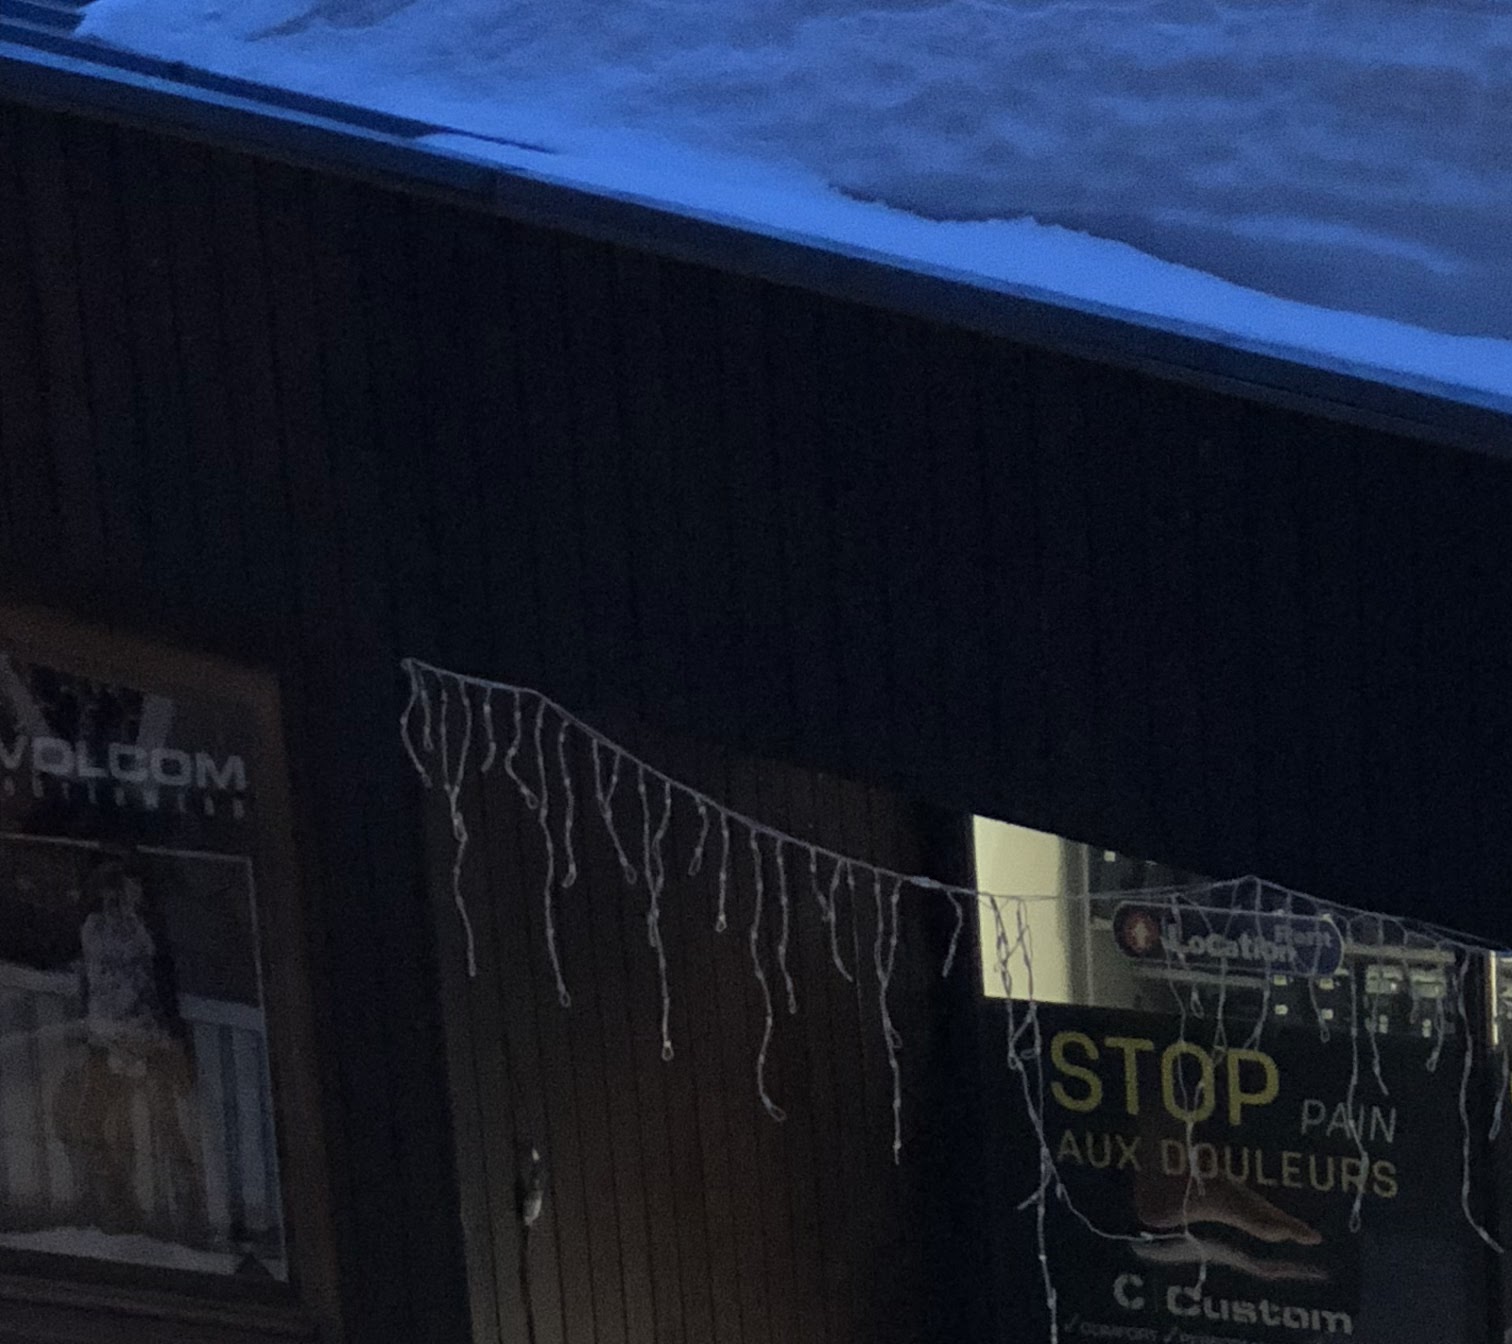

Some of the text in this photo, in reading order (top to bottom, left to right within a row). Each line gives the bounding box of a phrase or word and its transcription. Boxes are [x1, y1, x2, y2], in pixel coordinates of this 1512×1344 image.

[1050, 1030, 1280, 1126] STOP
[1301, 1098, 1397, 1145] PAIN
[1057, 1129, 1399, 1199] AUX DOULEURS
[1165, 1284, 1354, 1336] Custom
